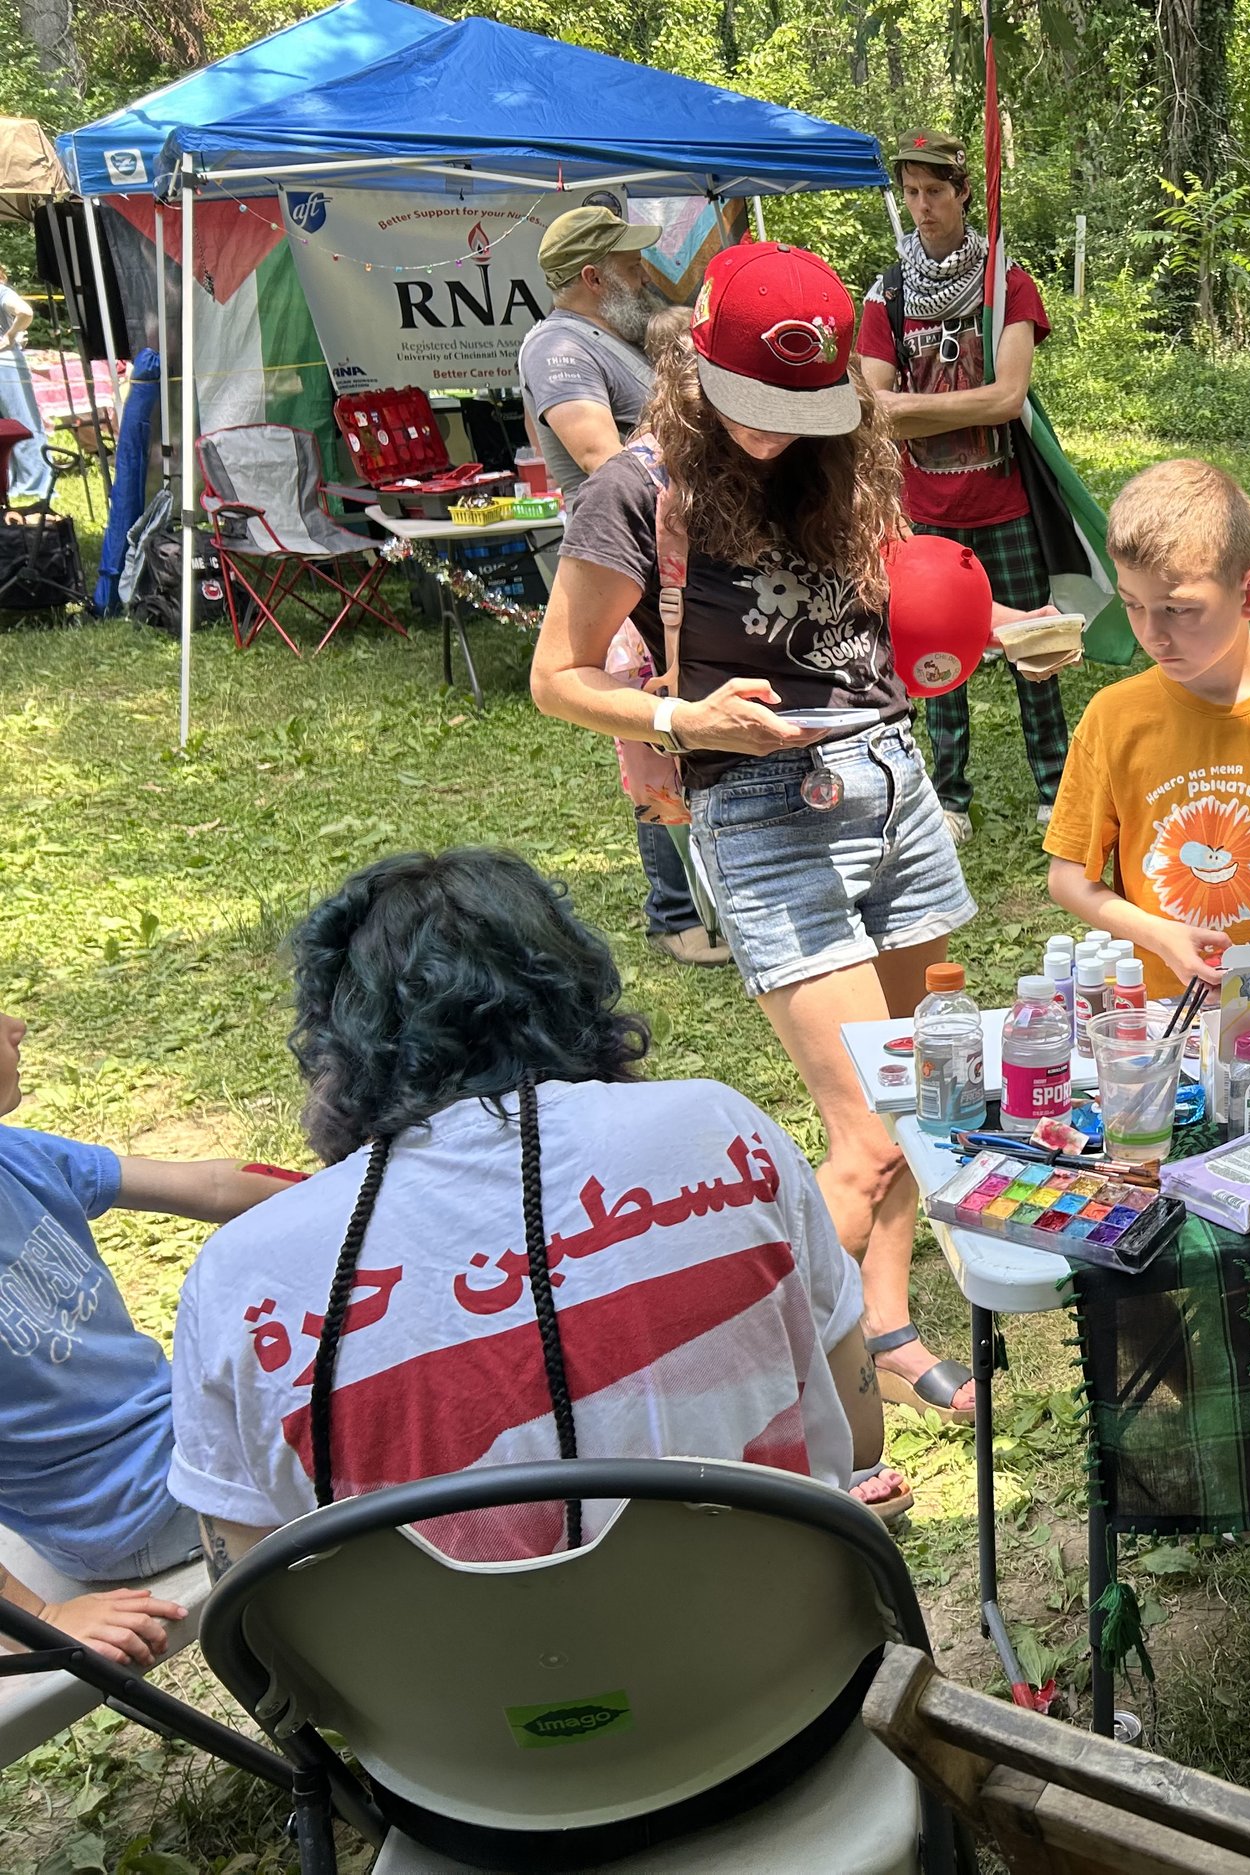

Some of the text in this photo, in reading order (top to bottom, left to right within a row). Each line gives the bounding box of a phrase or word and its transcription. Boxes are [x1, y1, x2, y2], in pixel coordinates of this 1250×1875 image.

[293, 191, 333, 229] aft
[378, 211, 412, 231] Better
[414, 207, 460, 220] Support
[462, 206, 479, 217] for
[480, 208, 504, 219] your
[393, 266, 545, 329] RNA
[397, 352, 441, 362] University
[443, 352, 452, 360] of
[454, 351, 498, 360] Cincinnati
[401, 339, 522, 353] Registered Nurses Asso
[433, 369, 467, 379] Better
[470, 368, 494, 378] Care
[496, 368, 512, 377] for
[803, 630, 871, 669] BLOOMS
[813, 619, 856, 650] LOVE
[1146, 765, 1244, 805] Нечего на меня
[453, 1133, 780, 1315] فلسطين
[244, 1266, 402, 1387] حرة
